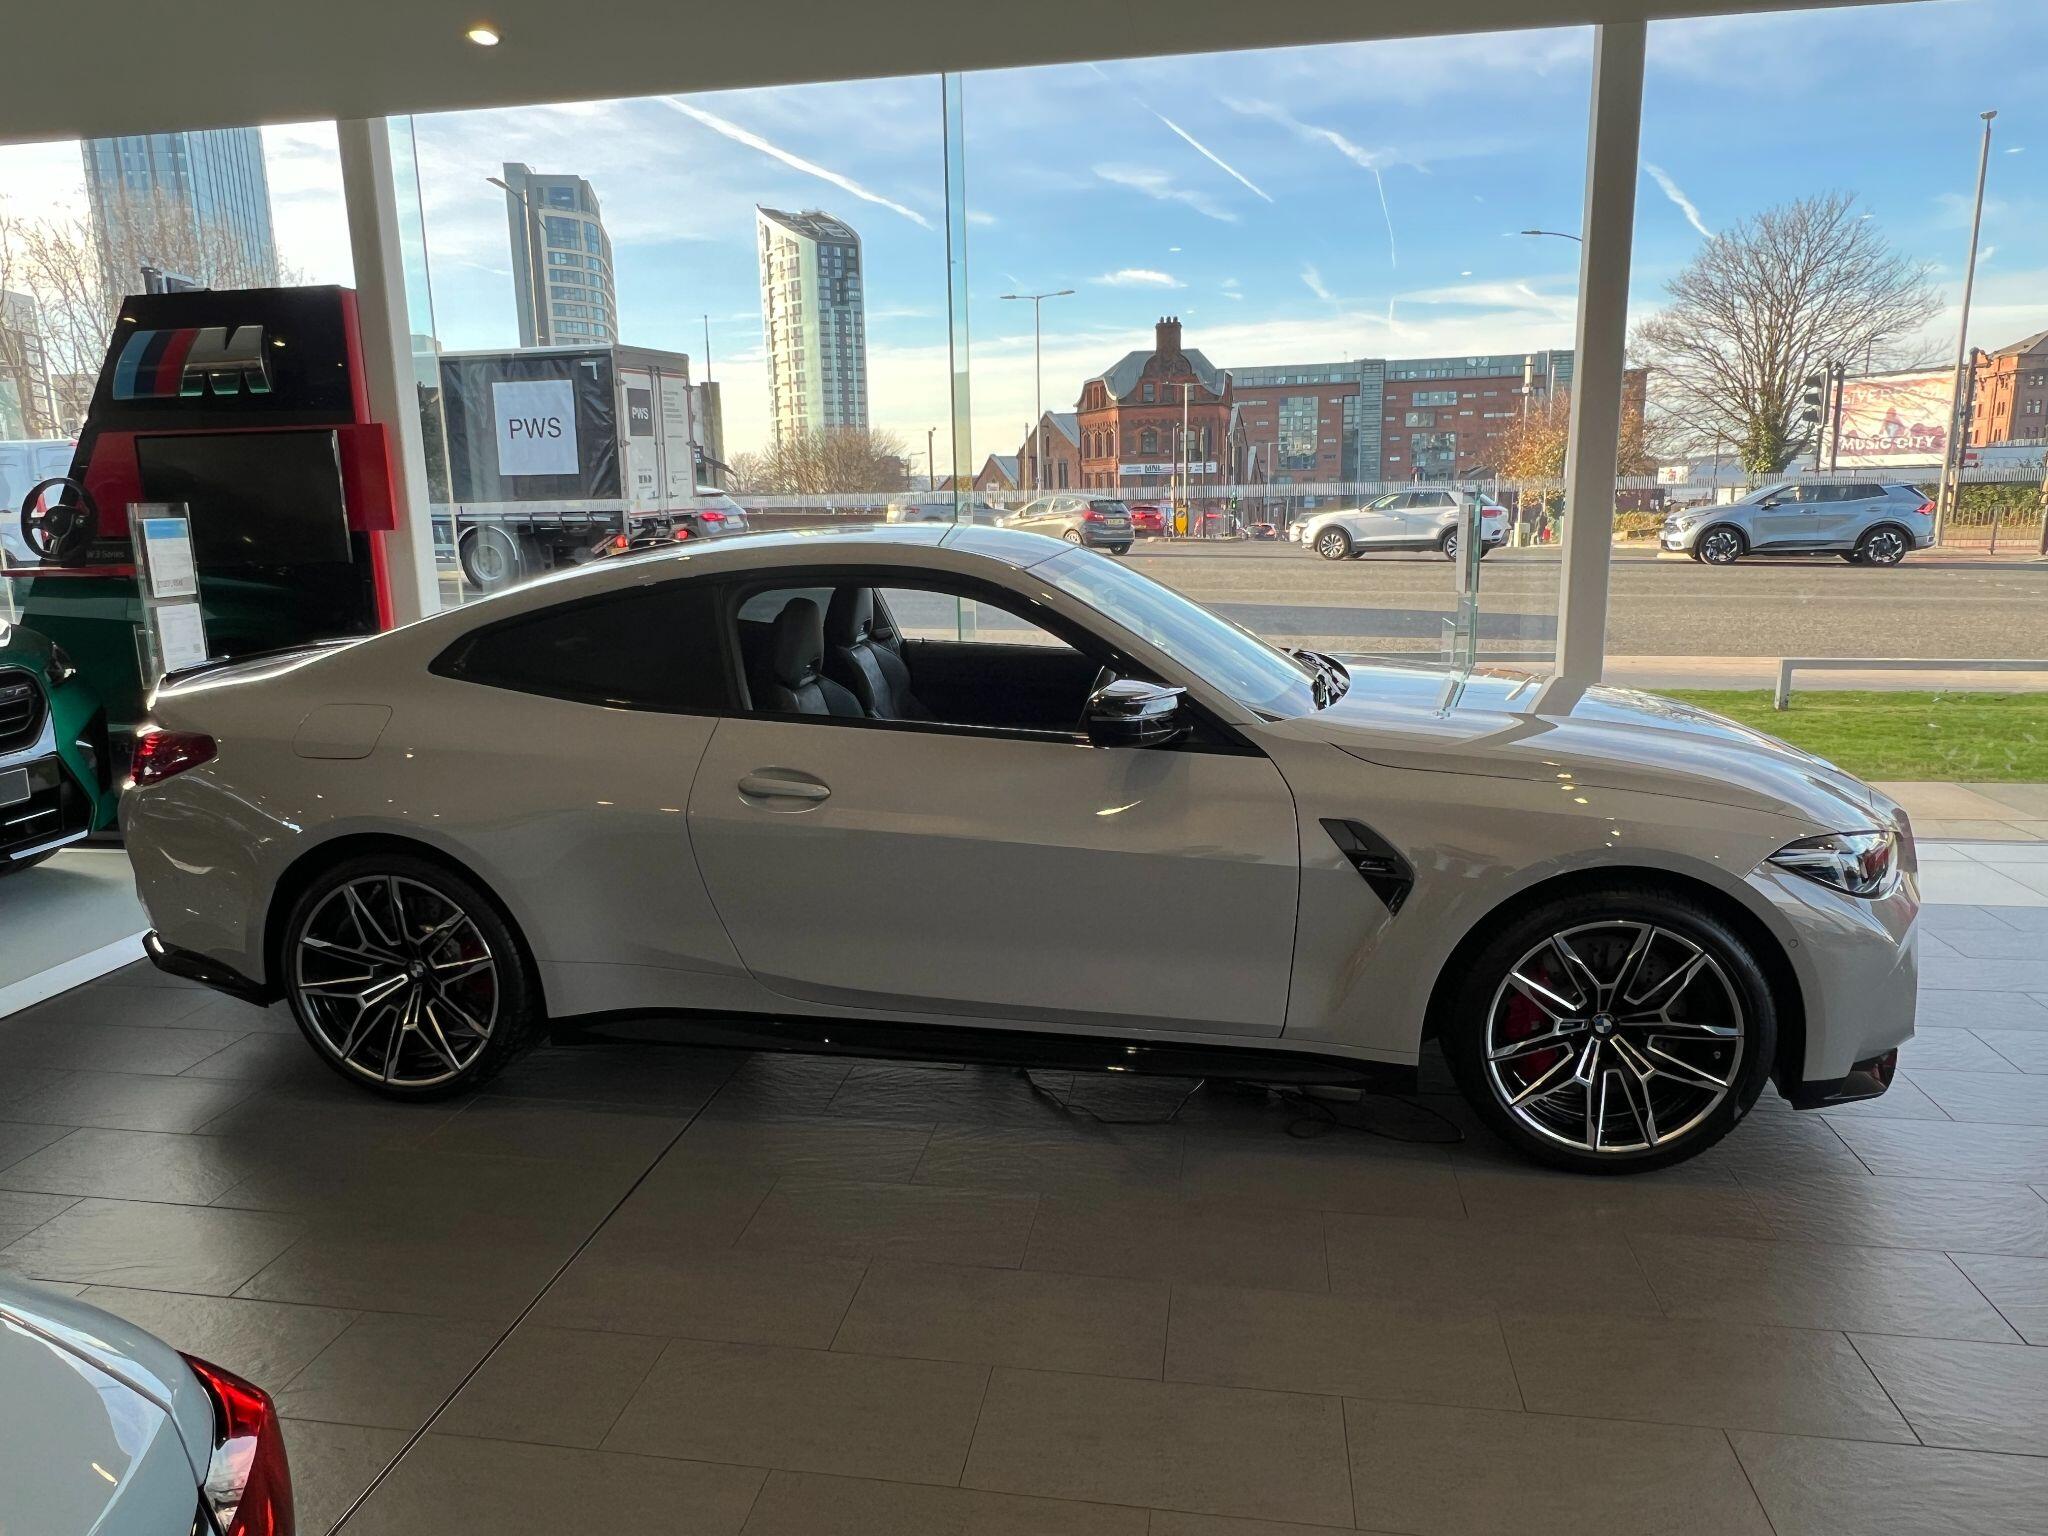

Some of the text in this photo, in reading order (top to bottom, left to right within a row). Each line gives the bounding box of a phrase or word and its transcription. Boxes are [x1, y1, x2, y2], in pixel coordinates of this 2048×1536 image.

[631, 406, 649, 420] PWS
[508, 417, 562, 439] PWS
[1839, 435, 1936, 451] MUSIC CITY
